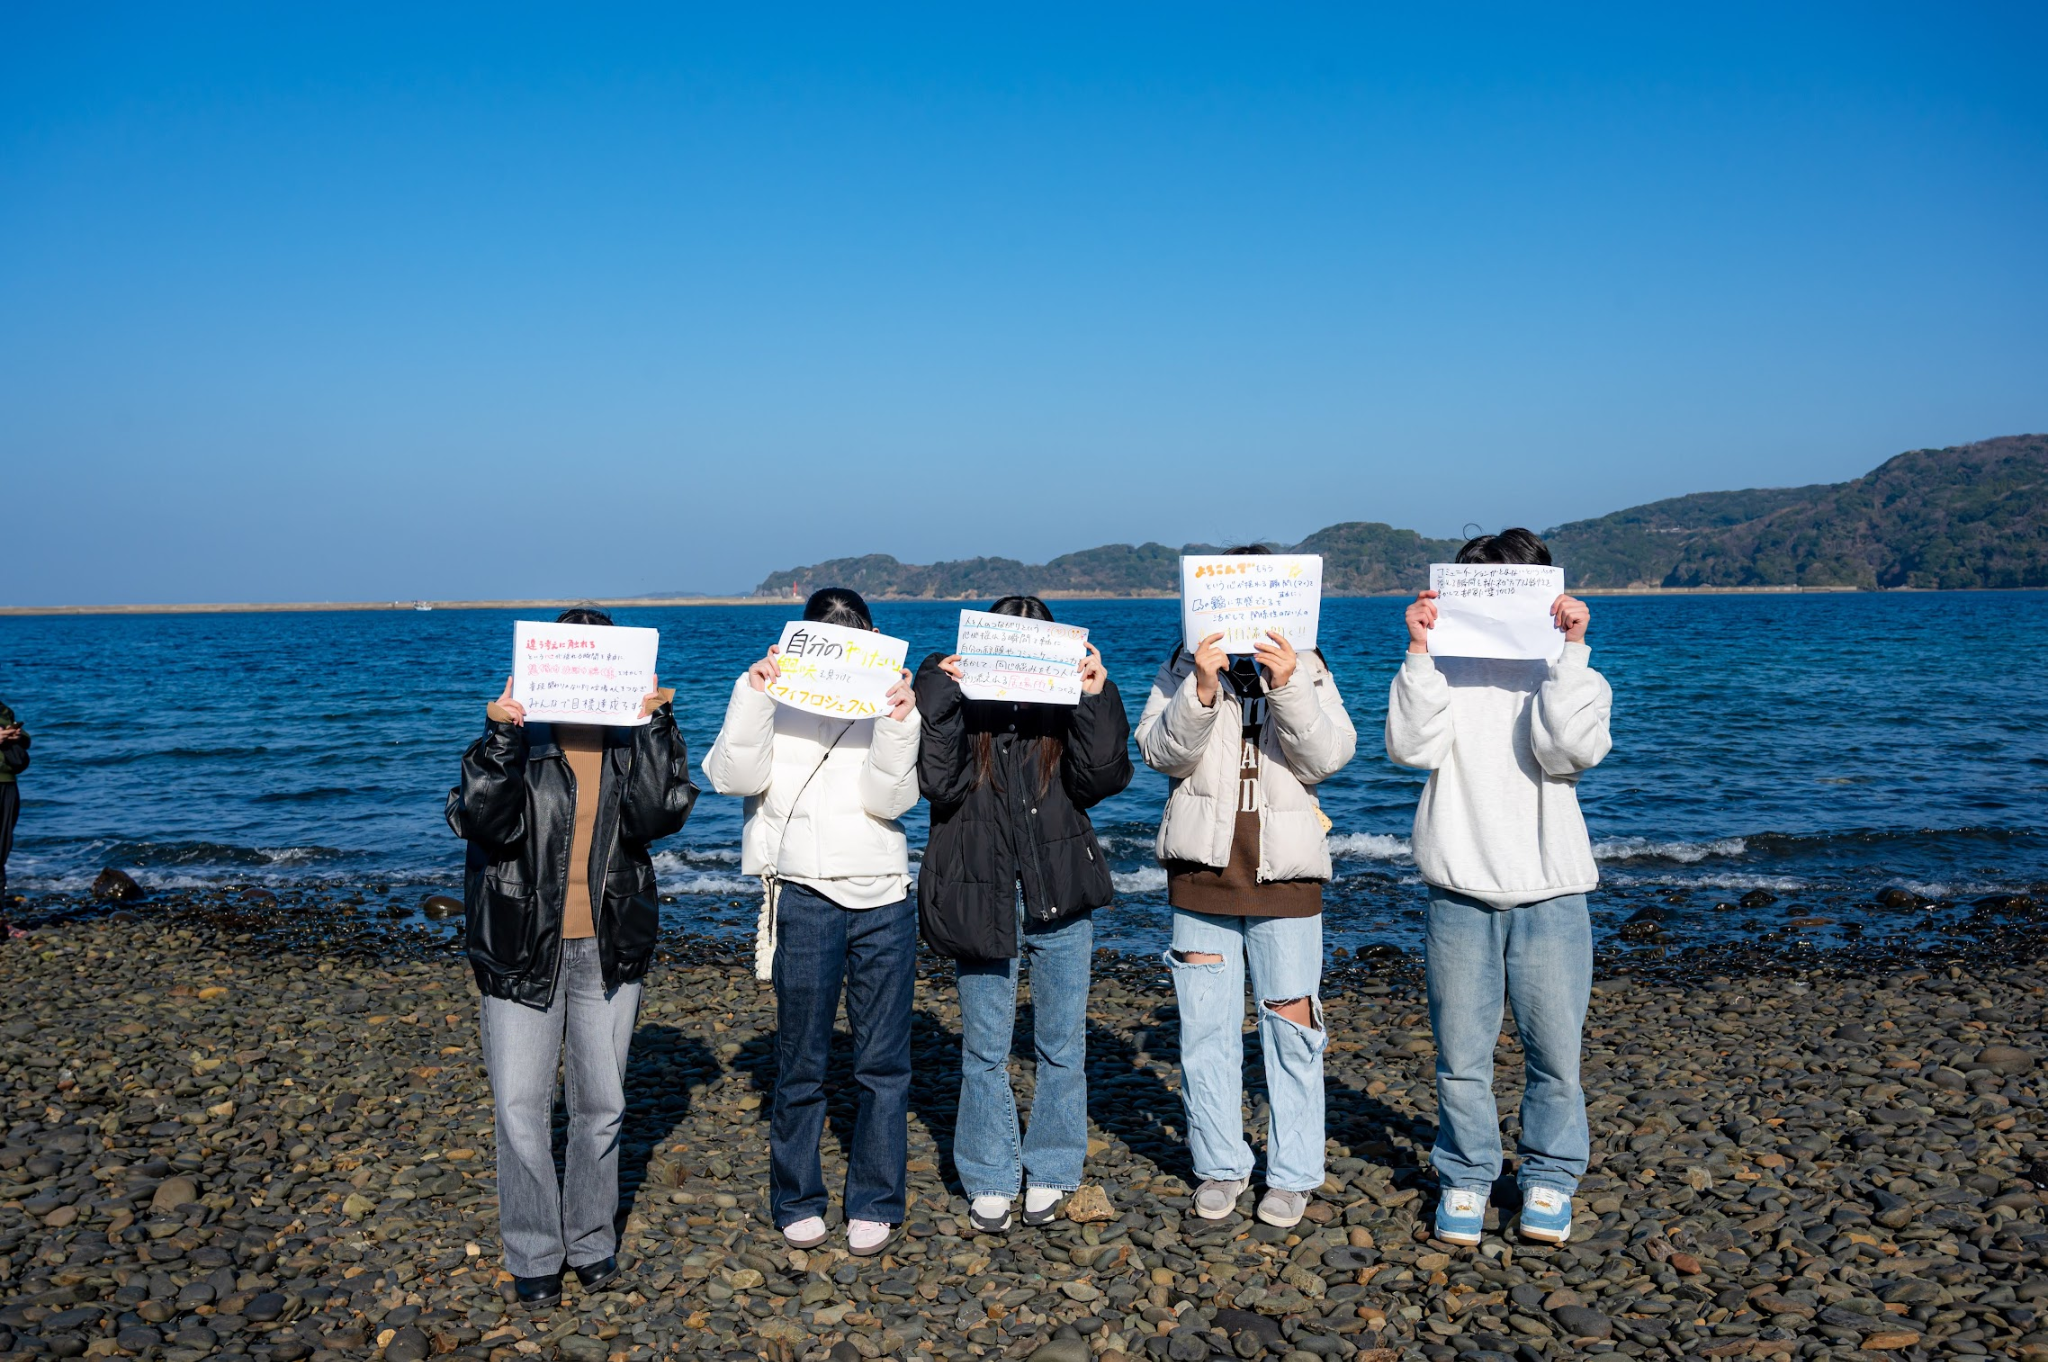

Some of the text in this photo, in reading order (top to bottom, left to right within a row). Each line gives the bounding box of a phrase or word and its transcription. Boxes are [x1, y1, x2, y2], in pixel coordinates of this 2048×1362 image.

[525, 638, 596, 651] 違う考えに触れる
